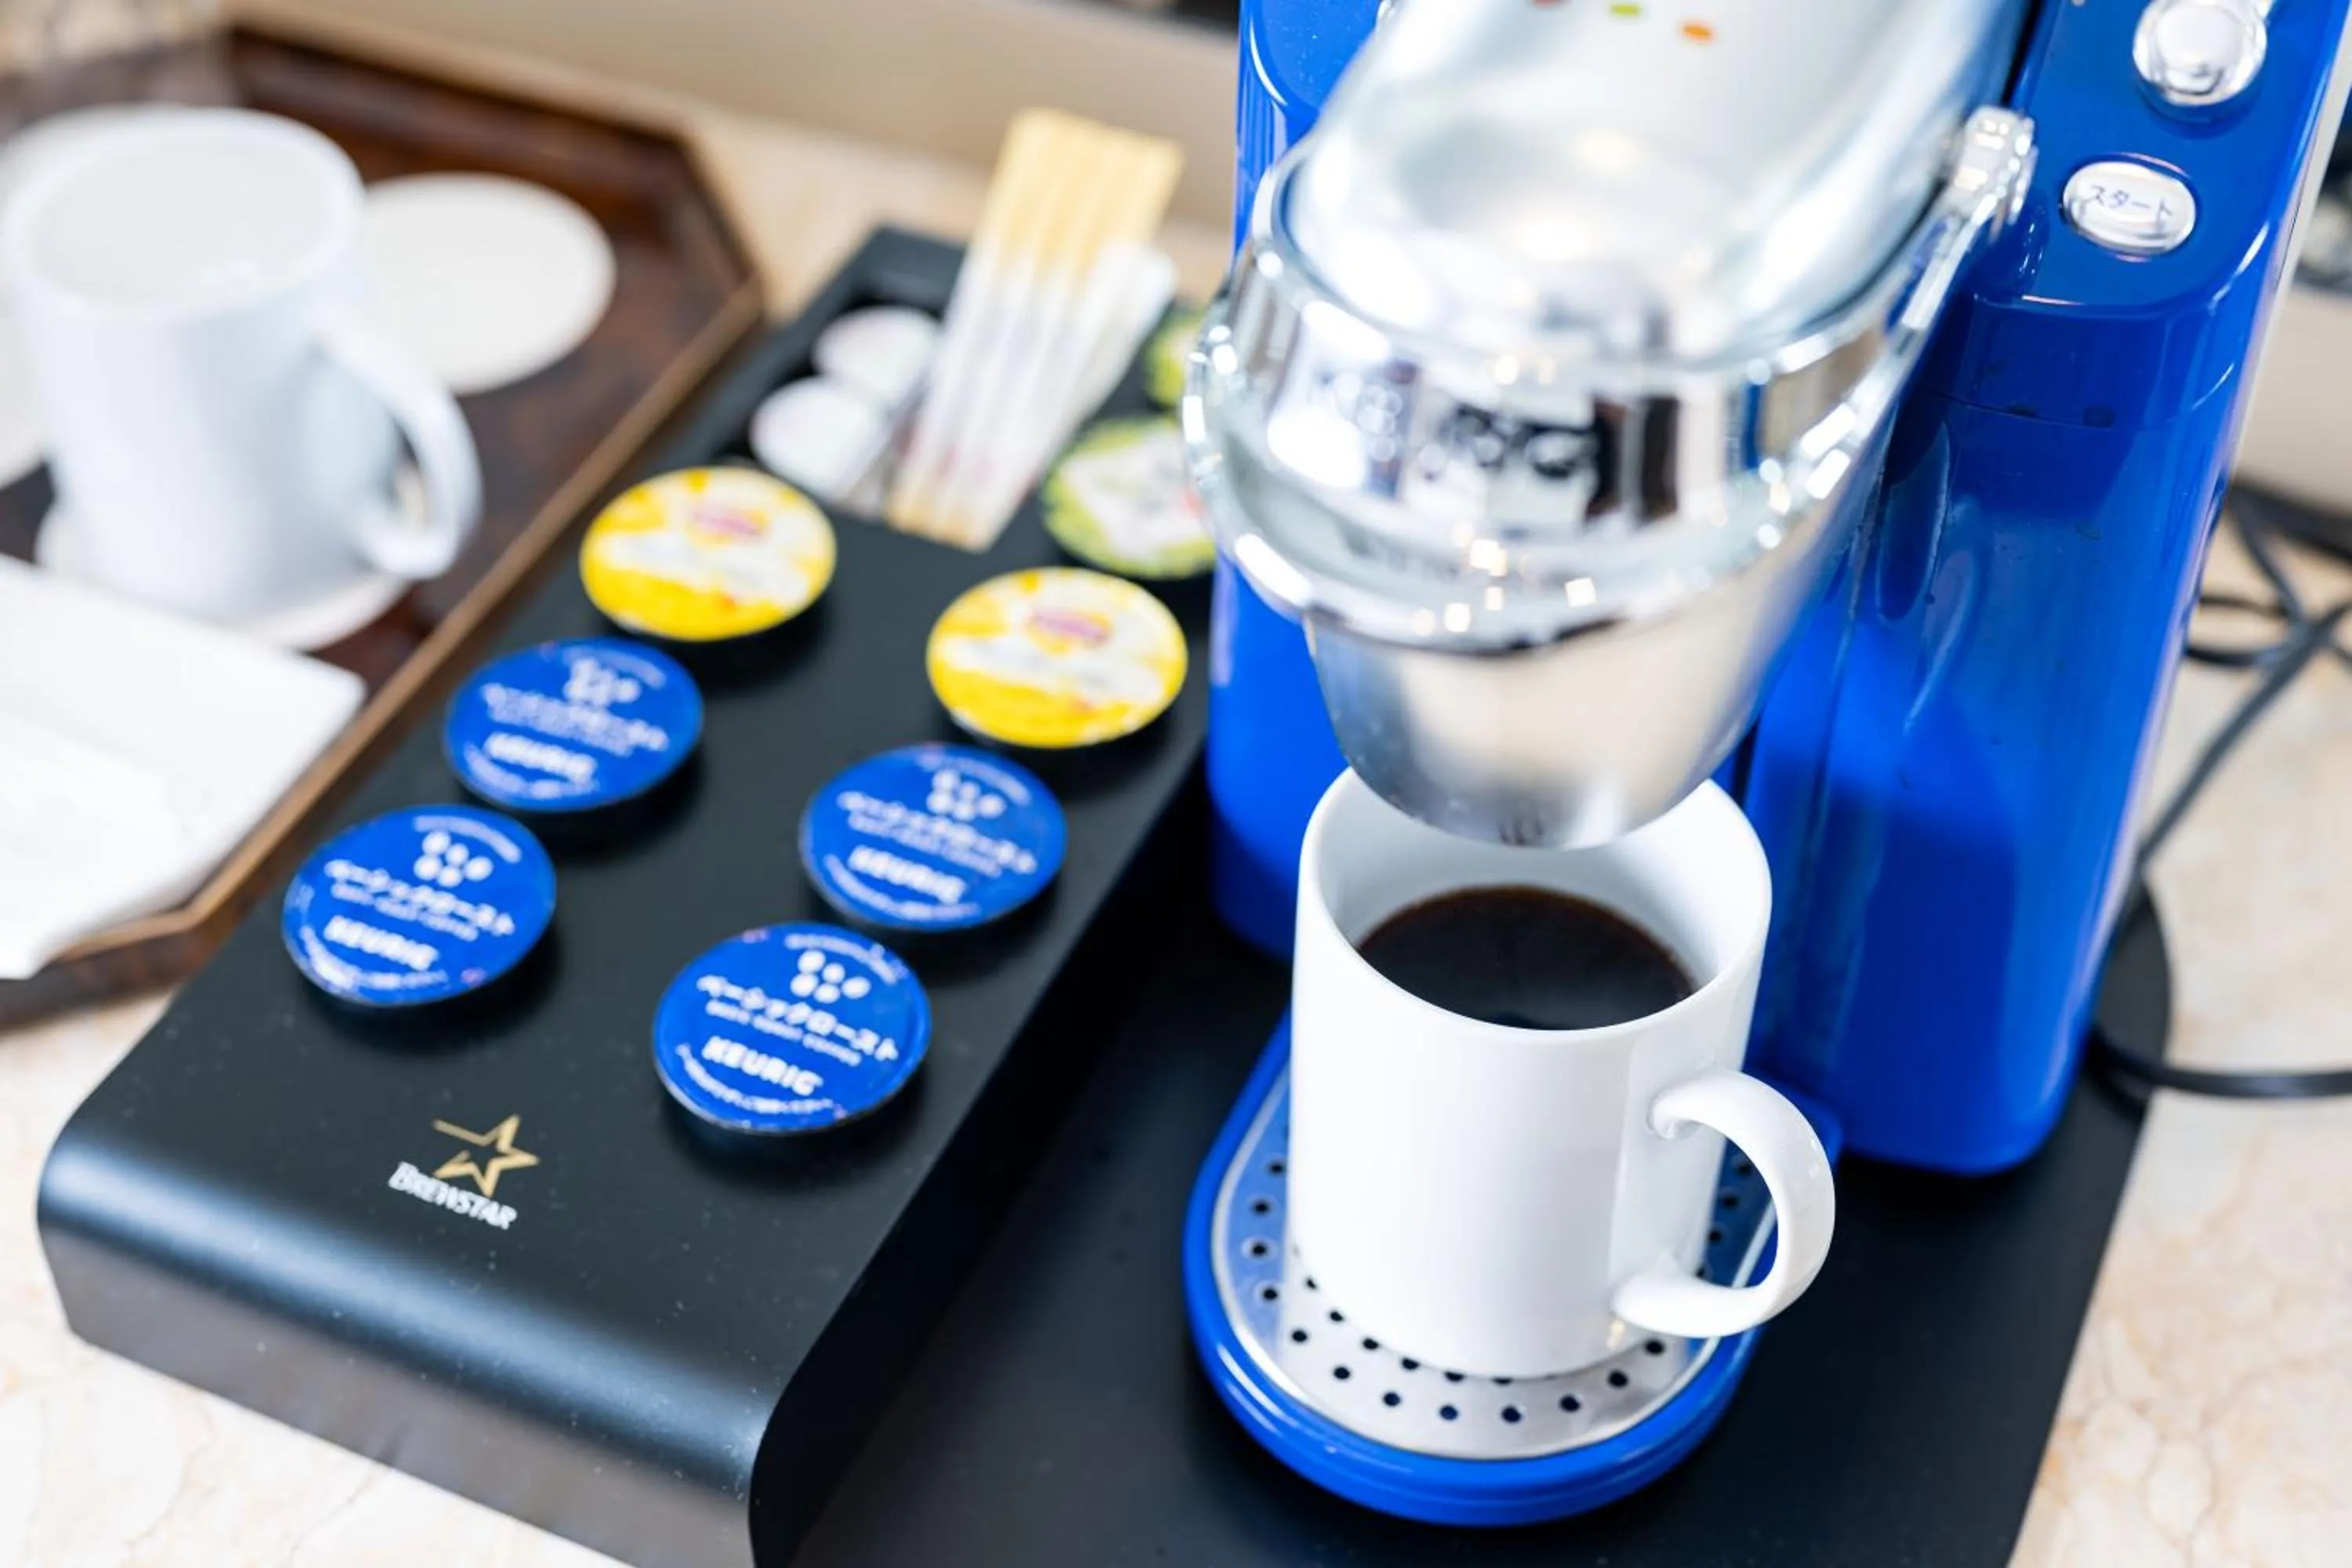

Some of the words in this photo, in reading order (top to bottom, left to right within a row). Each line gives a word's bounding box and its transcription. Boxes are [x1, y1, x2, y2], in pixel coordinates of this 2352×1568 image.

[2082, 183, 2175, 223] スタート
[702, 1036, 823, 1096] KEURIG
[388, 1161, 517, 1229] BREWSTAR
